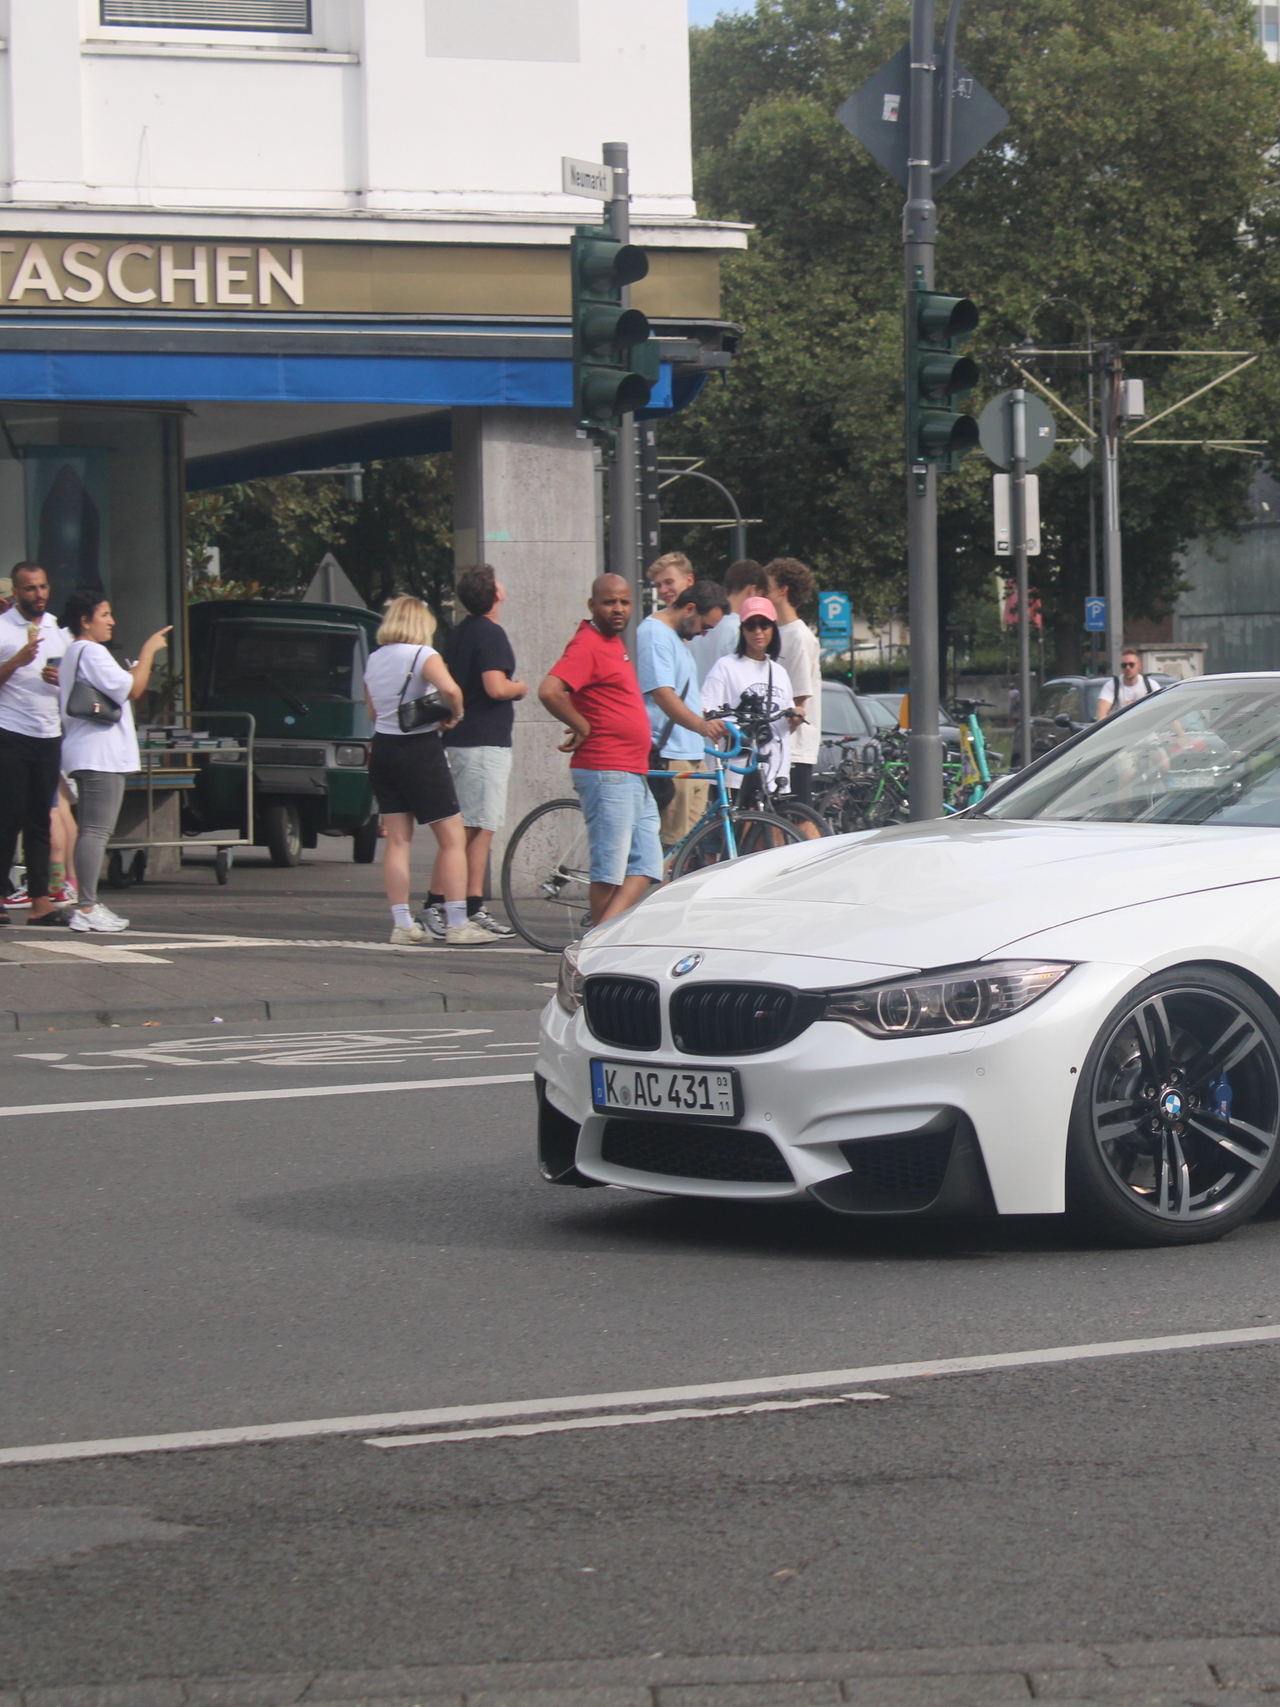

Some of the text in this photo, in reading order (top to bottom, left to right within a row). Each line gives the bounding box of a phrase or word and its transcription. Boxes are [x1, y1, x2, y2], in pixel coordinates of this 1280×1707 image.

[828, 603, 842, 619] P
[1092, 605, 1101, 618] P
[716, 1077, 728, 1086] 03
[605, 1069, 714, 1110] K AC 431
